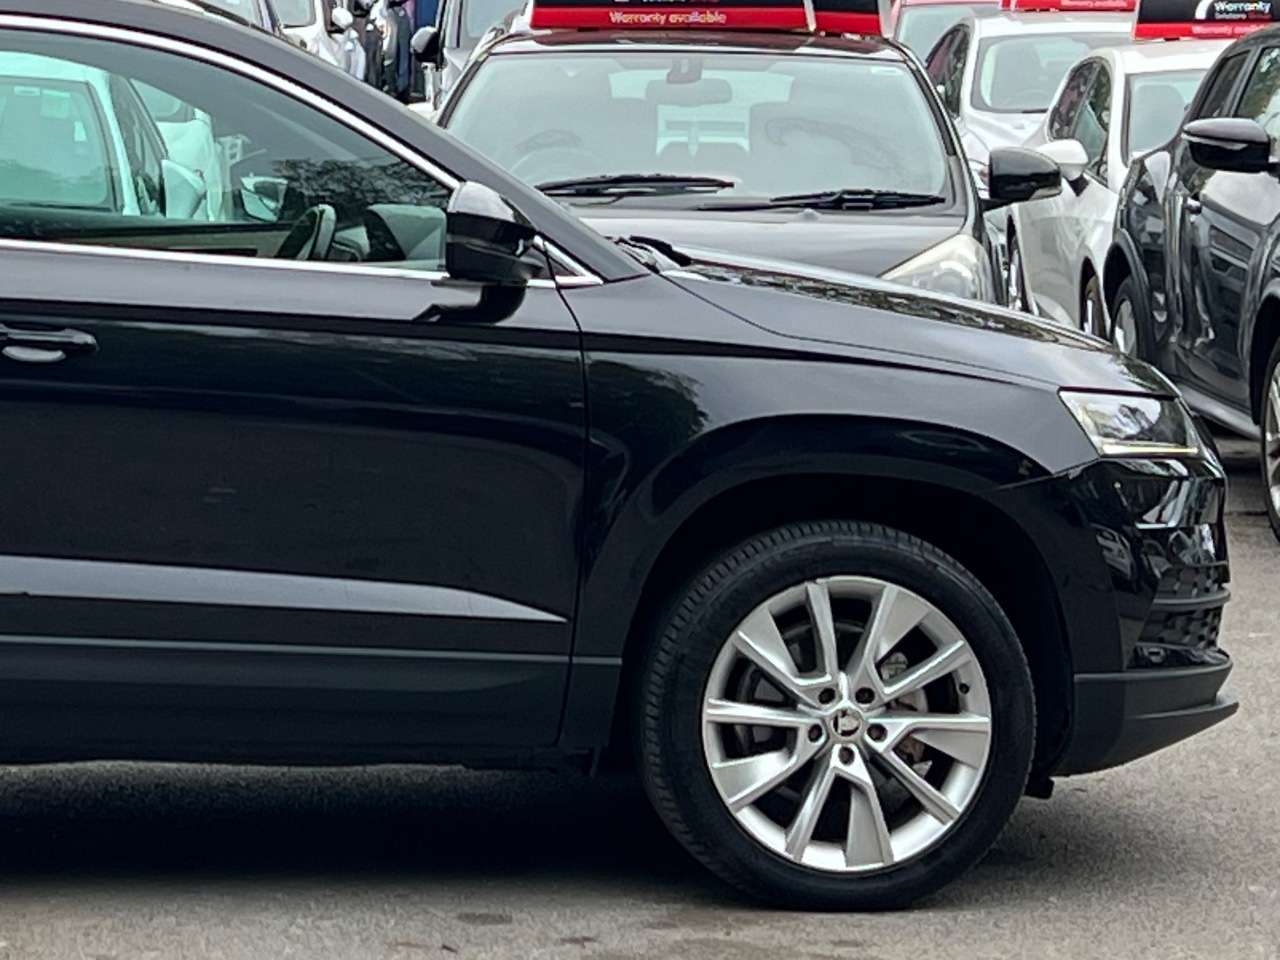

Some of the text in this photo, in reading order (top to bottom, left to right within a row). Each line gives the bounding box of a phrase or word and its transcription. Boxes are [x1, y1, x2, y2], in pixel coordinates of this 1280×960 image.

[1214, 0, 1271, 13] Warranty
[609, 9, 727, 25] Warranty available
